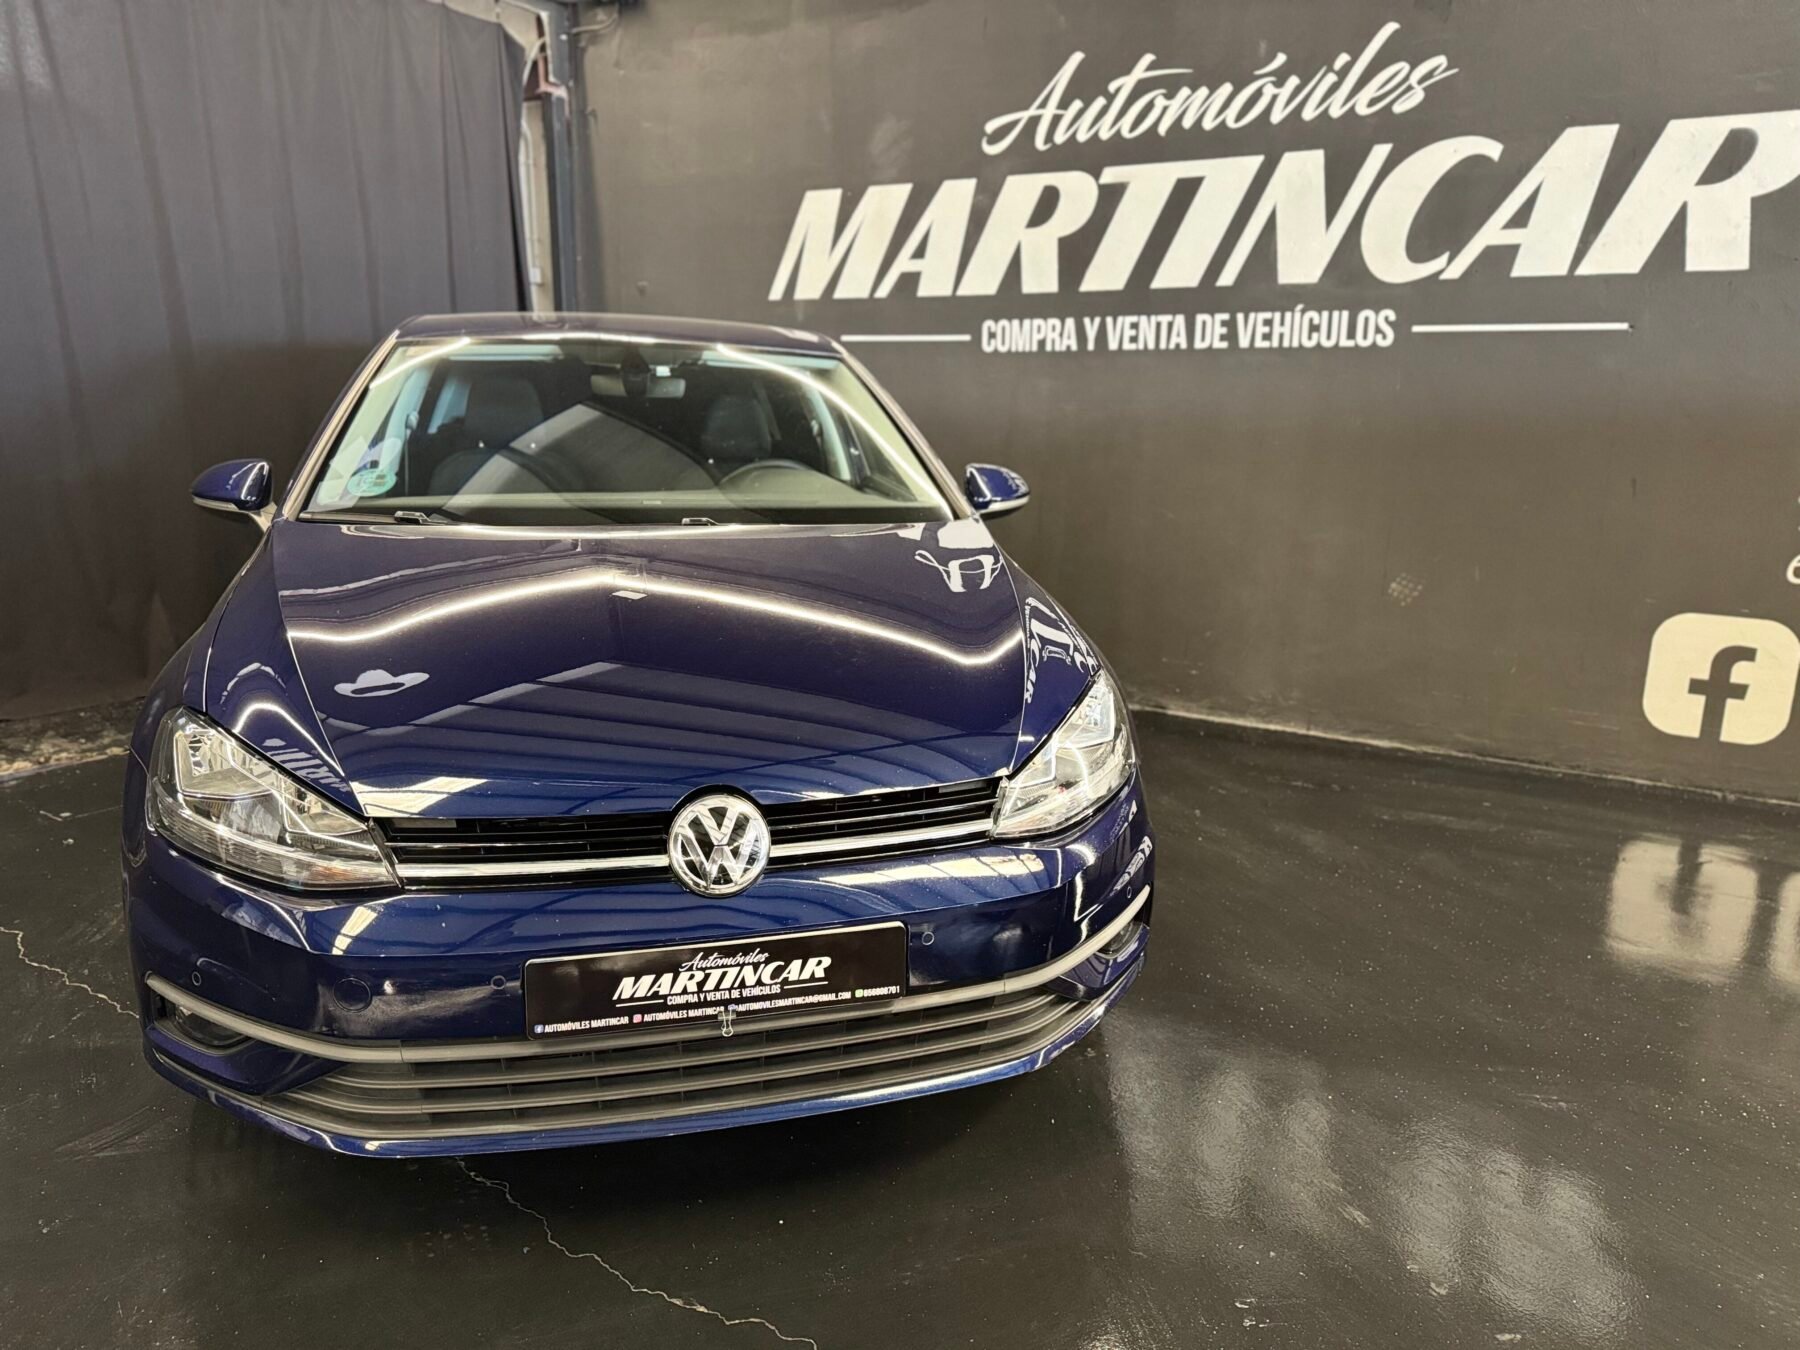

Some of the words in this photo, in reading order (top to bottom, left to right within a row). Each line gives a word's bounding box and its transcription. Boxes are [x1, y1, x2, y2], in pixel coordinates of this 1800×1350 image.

[981, 21, 1459, 155] Automóviles
[767, 109, 1800, 301] MARTINCAR
[981, 317, 1078, 353] COMPRA
[1082, 317, 1101, 351] Y
[1105, 314, 1188, 351] VENTA
[1193, 313, 1230, 349] DE
[1236, 304, 1396, 349] VEHÍCULOS
[679, 948, 769, 972] Automóviles
[612, 956, 832, 1001] MARTINCAR
[666, 993, 698, 1006] COMPRA
[700, 993, 706, 1002] Y
[706, 990, 729, 1002] VENTA
[731, 988, 741, 998] DE
[742, 983, 781, 998] VEHÍCULOS
[591, 1016, 629, 1028] MARTINCAR
[688, 1005, 725, 1018] MARTINCAR
